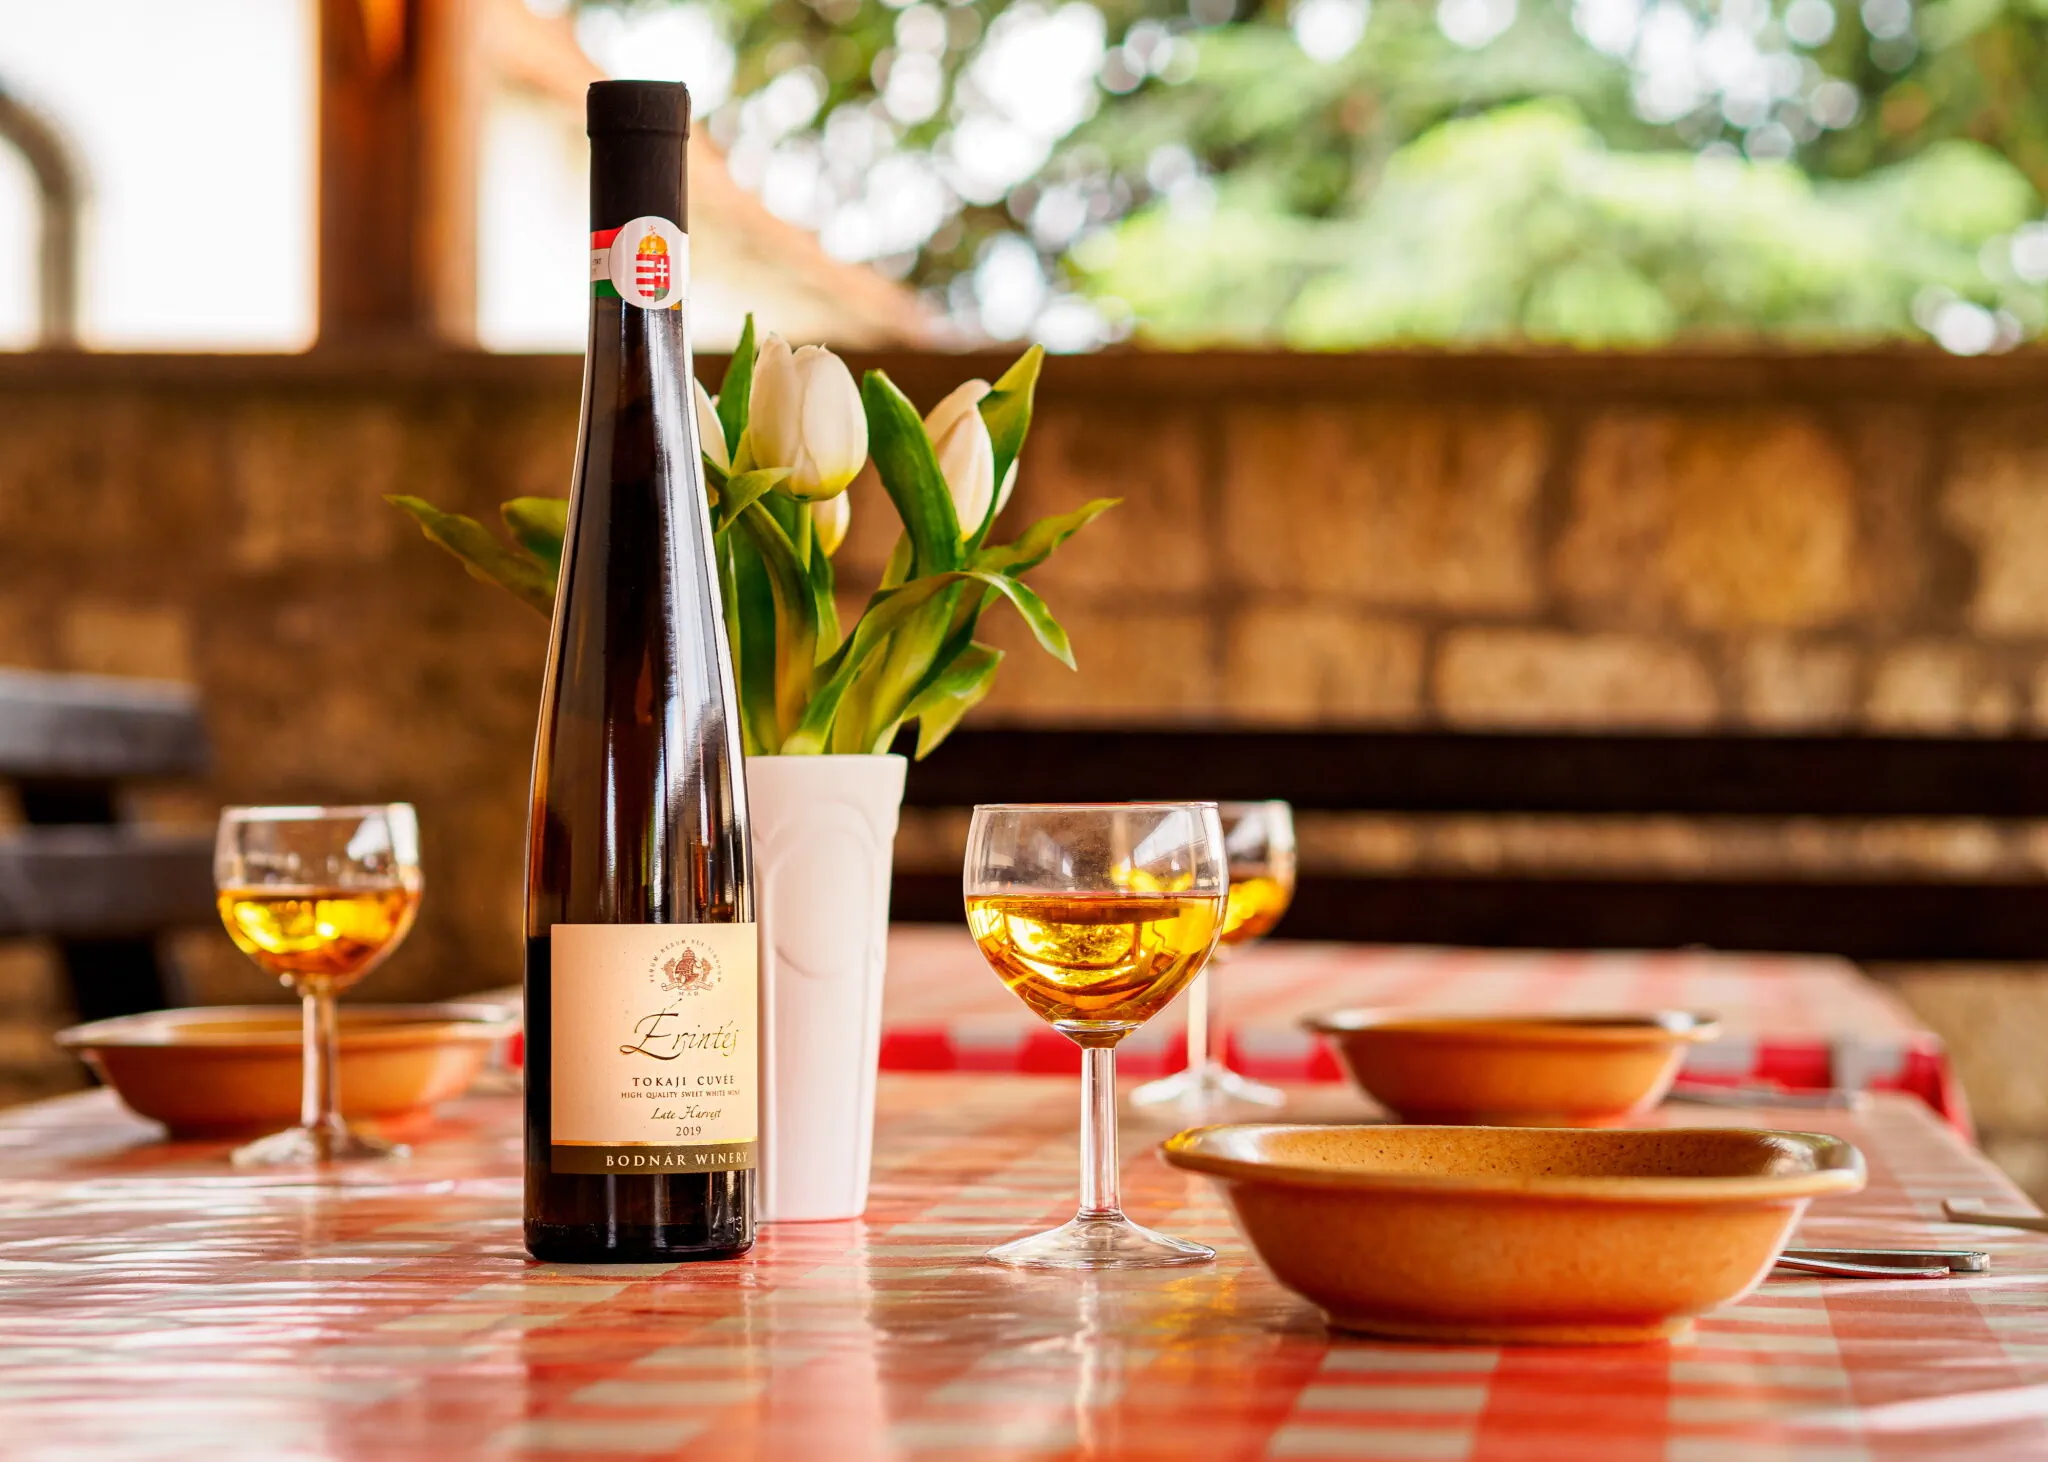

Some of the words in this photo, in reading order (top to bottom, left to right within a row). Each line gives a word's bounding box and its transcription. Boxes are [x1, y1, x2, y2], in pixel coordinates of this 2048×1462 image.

[632, 1077, 687, 1087] TOKAJI
[697, 1074, 734, 1085] CUVÉE
[646, 1091, 677, 1099] QUALITY
[681, 1090, 702, 1098] SWEET
[706, 1089, 725, 1097] WHITE
[650, 1107, 676, 1120] Late
[678, 1104, 722, 1121] Harvest
[676, 1126, 702, 1137] 2019
[606, 1153, 687, 1167] BODNÁR
[695, 1151, 748, 1165] WINERY
